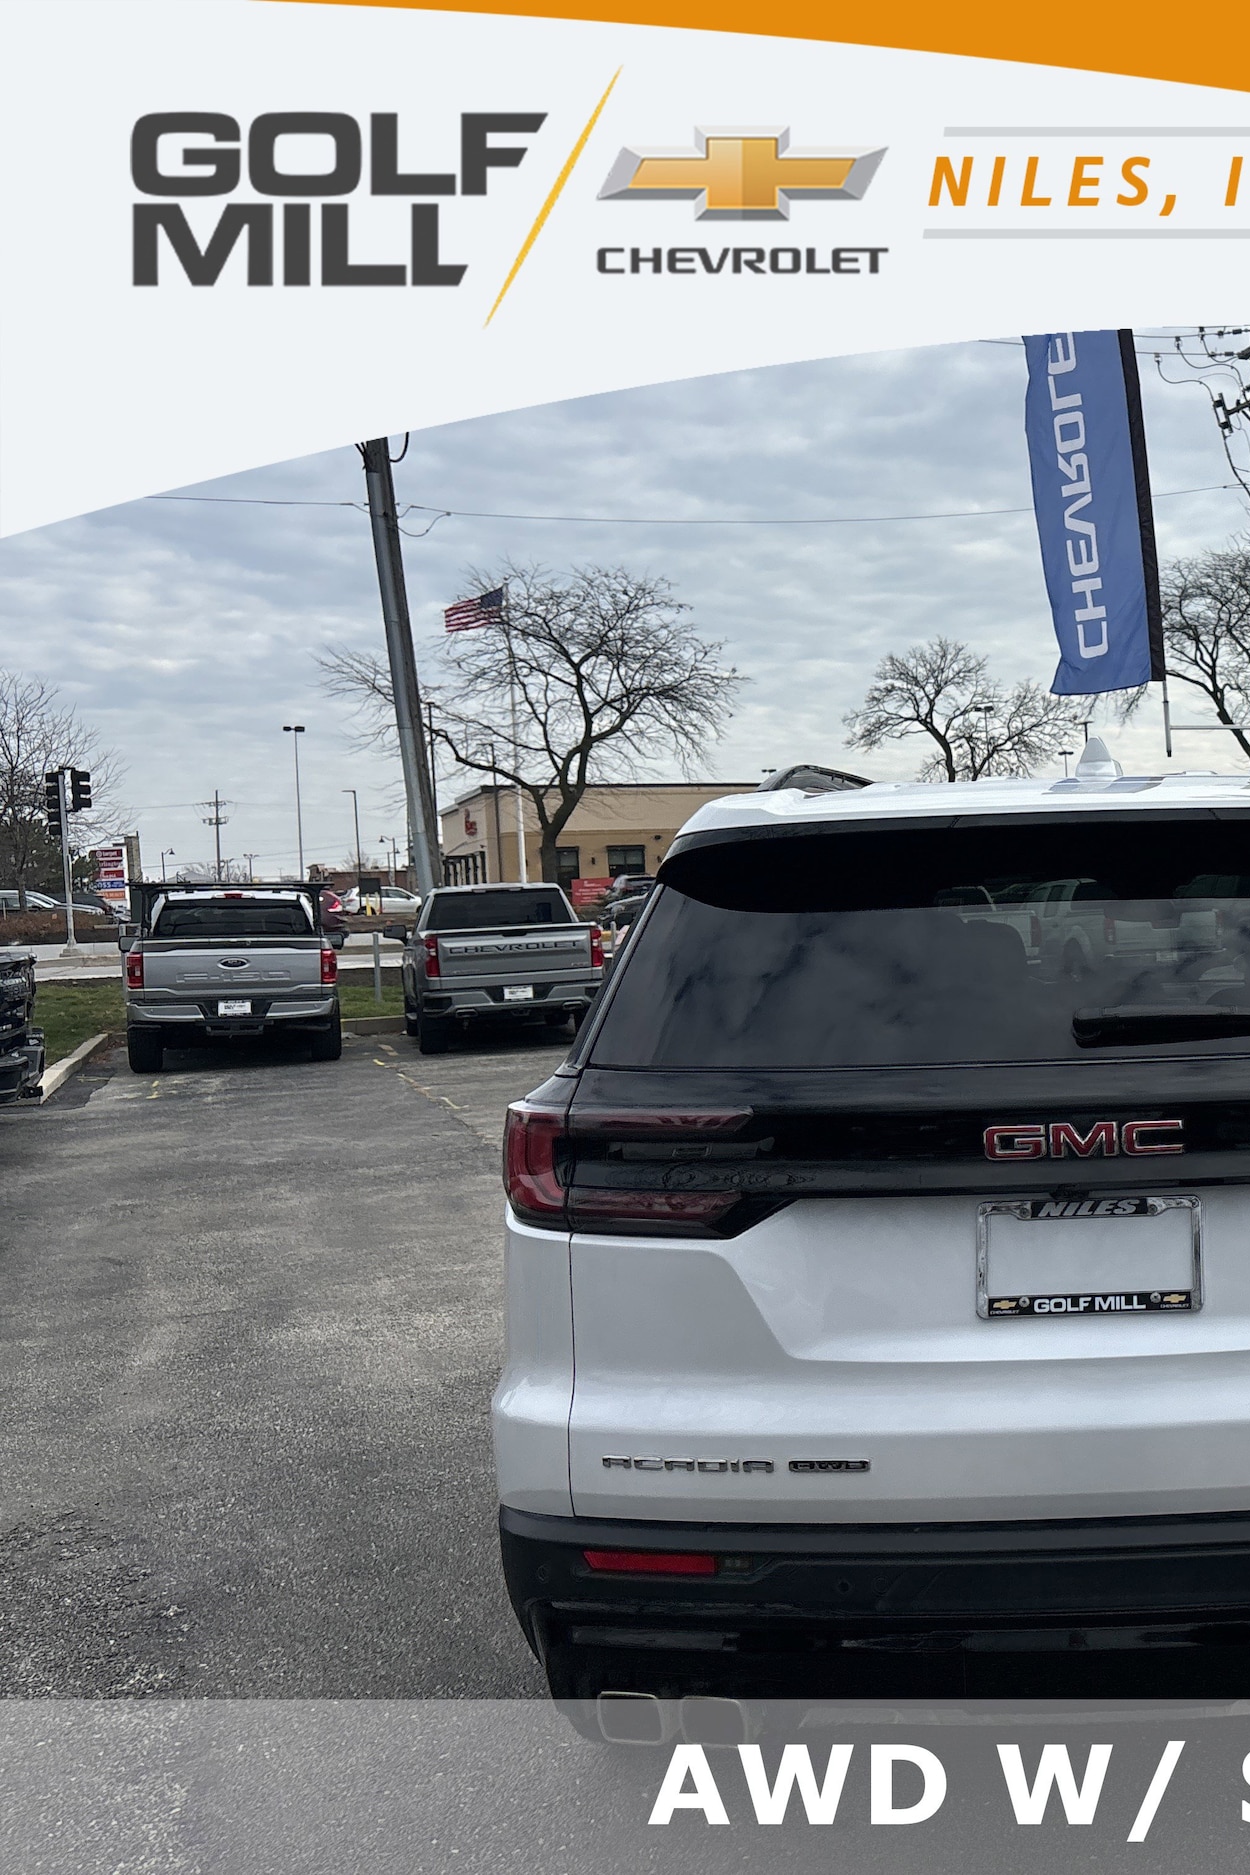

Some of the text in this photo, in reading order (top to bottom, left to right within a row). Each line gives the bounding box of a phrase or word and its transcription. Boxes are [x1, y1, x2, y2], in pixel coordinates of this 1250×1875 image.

[450, 940, 580, 954] CHEVROLET
[176, 970, 291, 983] F-150
[983, 1120, 1184, 1160] GMC
[1039, 1199, 1138, 1217] NILES
[1033, 1295, 1147, 1313] GOLF MILL
[602, 1455, 870, 1473] ACADIA AWD
